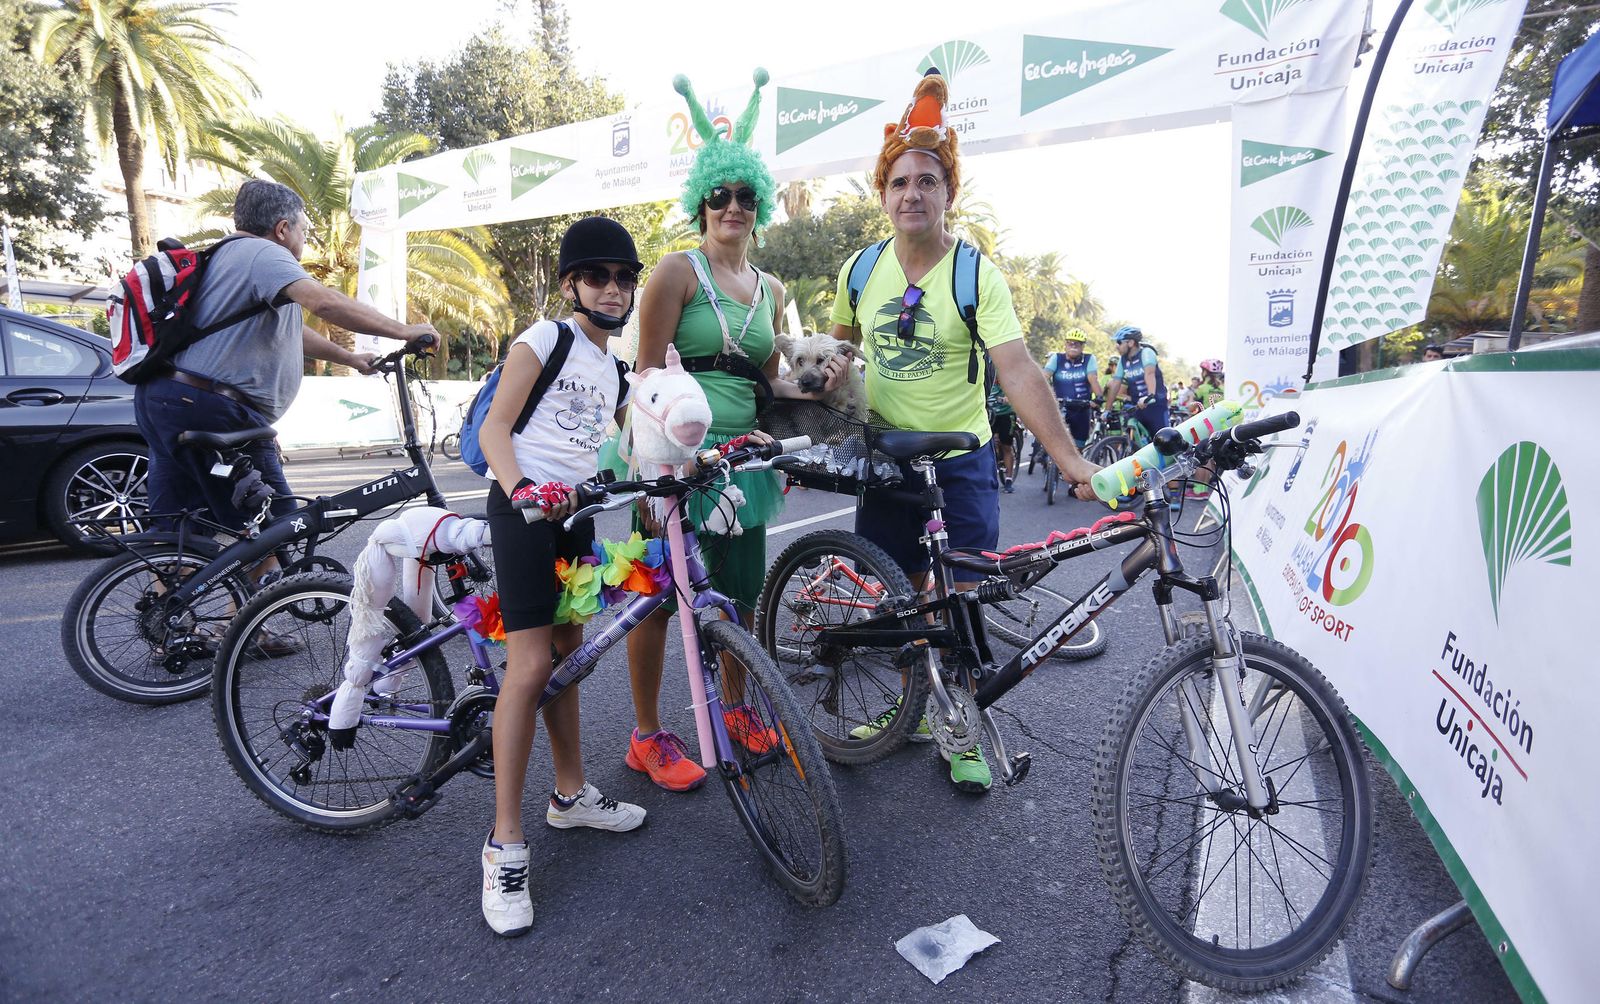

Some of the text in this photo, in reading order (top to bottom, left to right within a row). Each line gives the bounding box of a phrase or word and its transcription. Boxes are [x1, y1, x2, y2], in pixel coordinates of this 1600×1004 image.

[1217, 37, 1320, 68] Fundación
[1417, 36, 1496, 53] undación
[1024, 49, 1137, 81] El Corte Inglés
[1414, 57, 1474, 74] Unicaja
[1230, 64, 1303, 90] Unicaja
[778, 100, 859, 126] El Corte Inglés
[1242, 156, 1253, 167] El
[1253, 155, 1278, 166] Corte
[594, 161, 648, 179] Ayuntamiento
[463, 186, 497, 199] Fundación
[601, 181, 611, 190] de
[467, 202, 492, 212] Unicaja
[1250, 250, 1313, 262] Fundación
[1258, 265, 1302, 277] Unicaja
[1244, 333, 1312, 346] Ayuntamient
[1252, 346, 1309, 357] de Málaga
[557, 376, 586, 393] Let's
[896, 608, 918, 618] 500
[1299, 596, 1314, 615] OF
[1310, 605, 1355, 642] SPORT
[1021, 581, 1114, 665] TOPBIKE
[1441, 630, 1533, 755] Fundación
[1436, 697, 1503, 806] Unicaja
